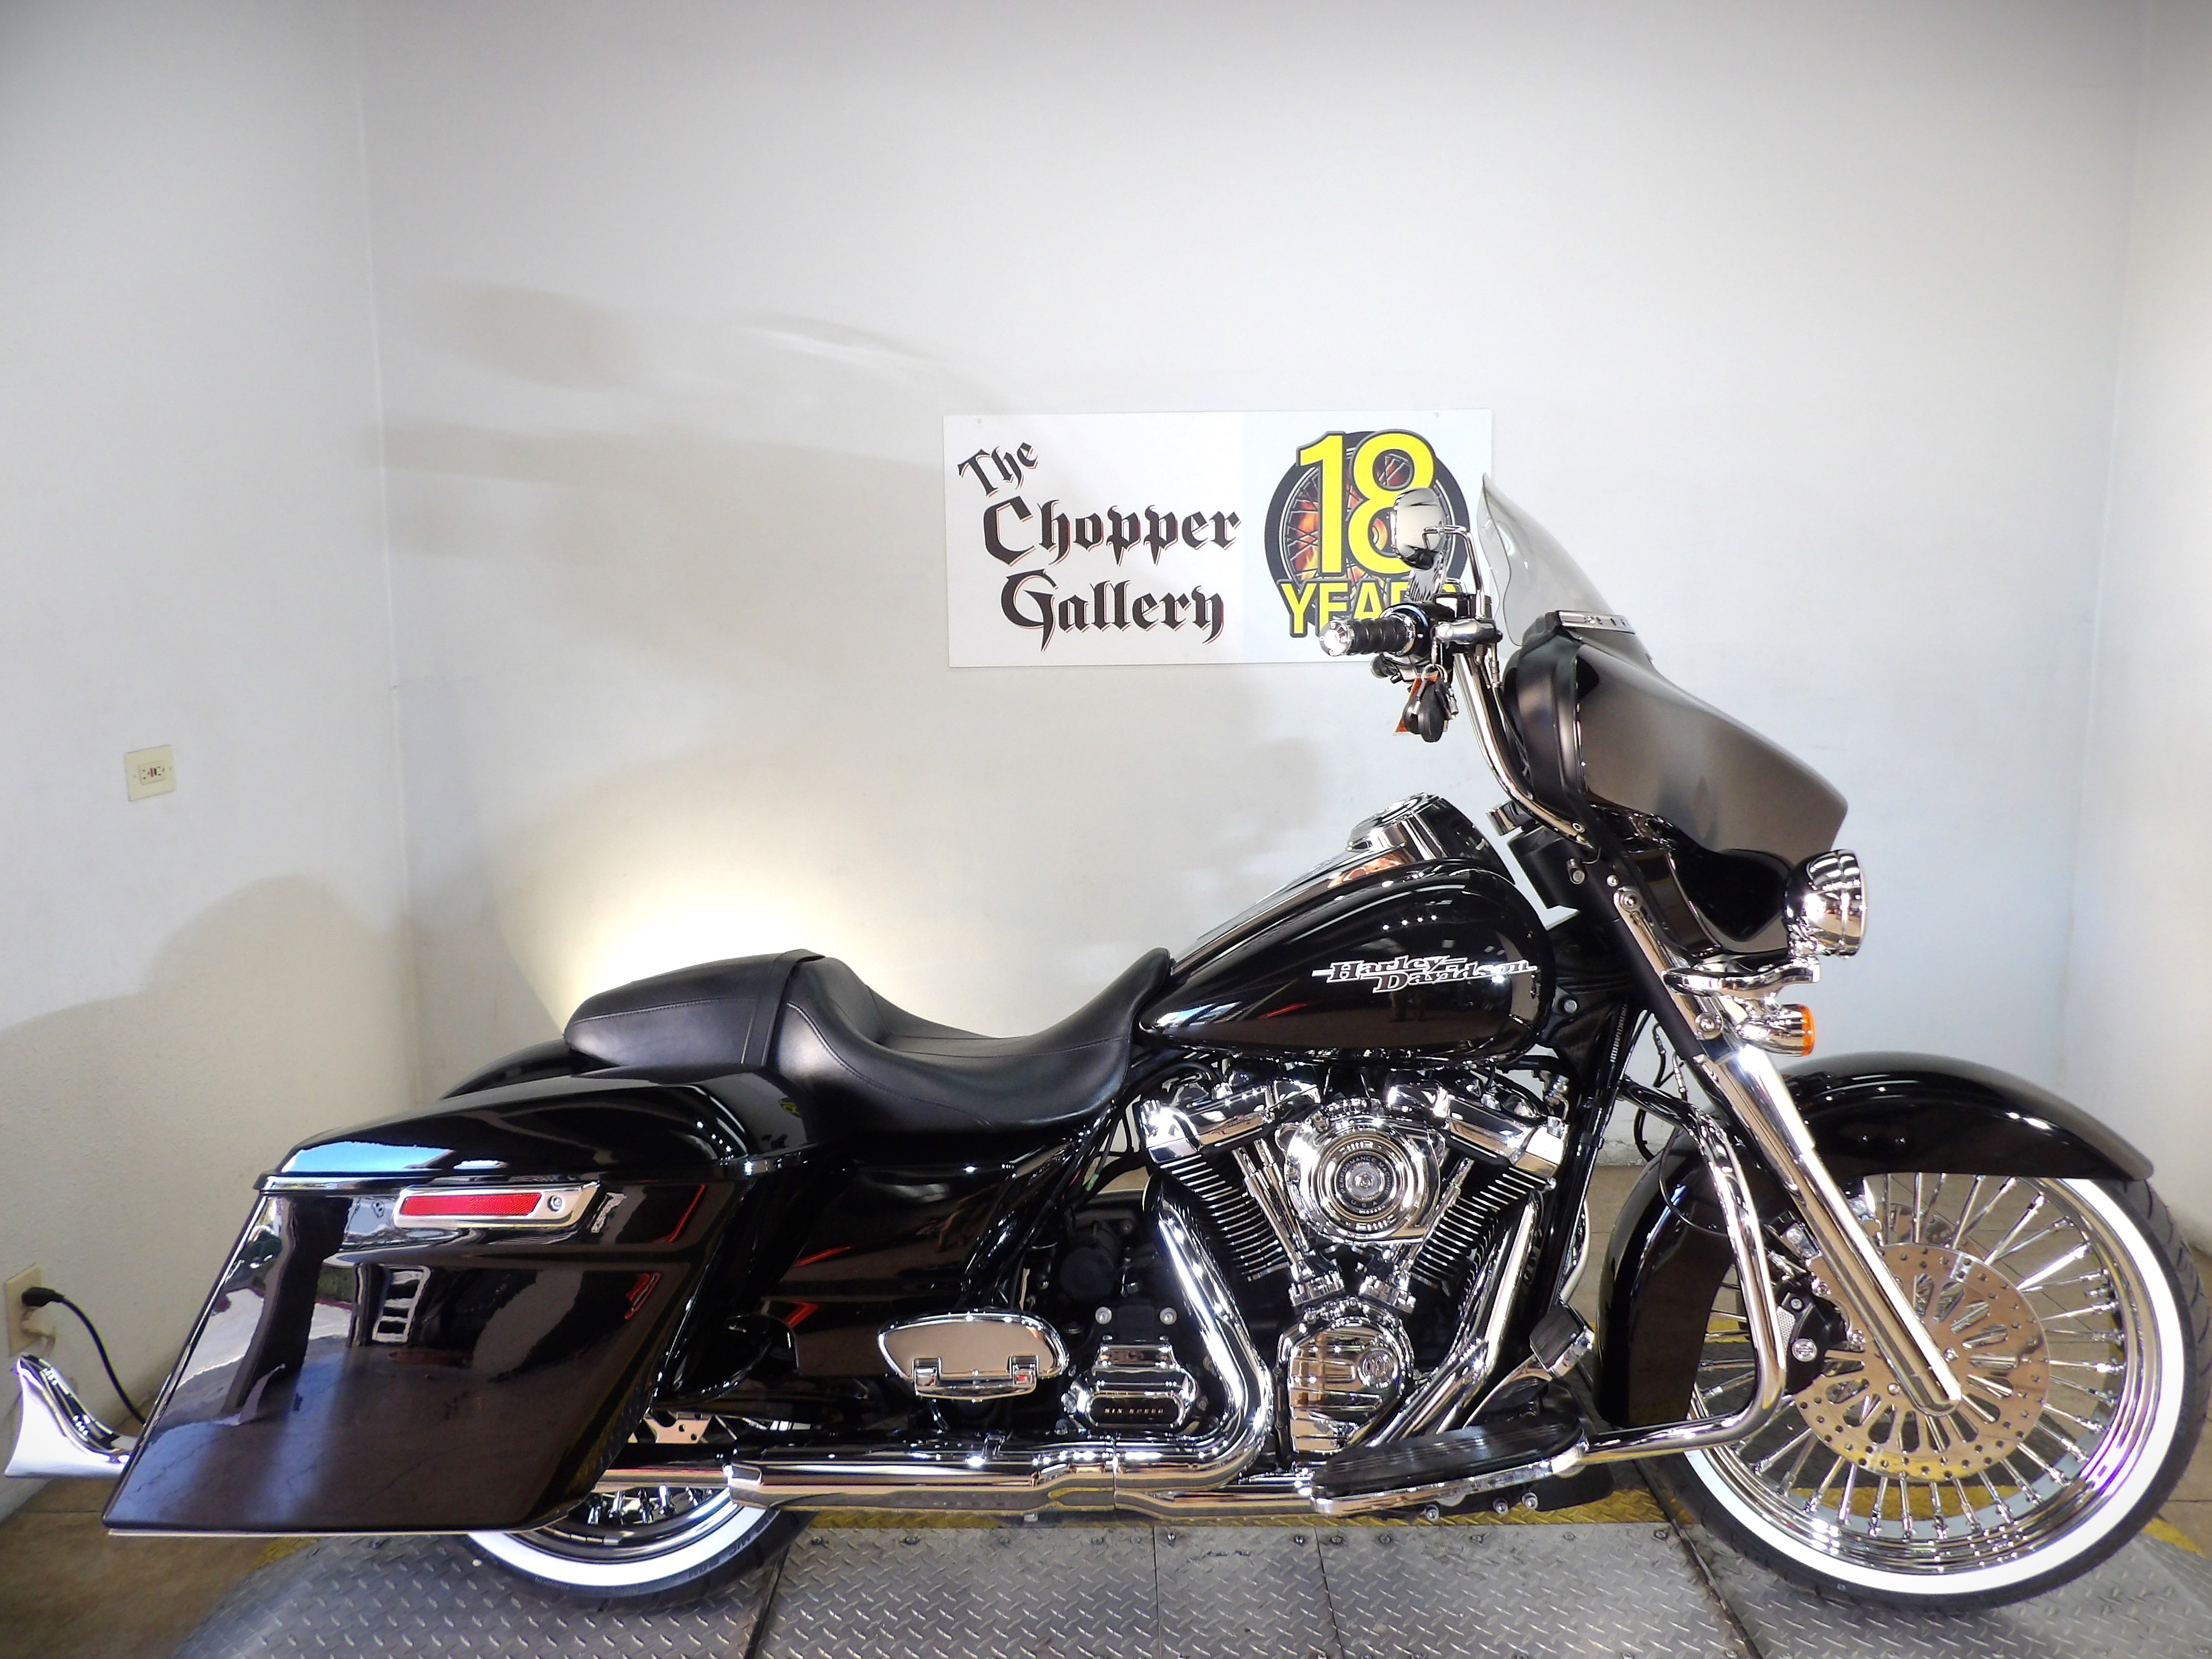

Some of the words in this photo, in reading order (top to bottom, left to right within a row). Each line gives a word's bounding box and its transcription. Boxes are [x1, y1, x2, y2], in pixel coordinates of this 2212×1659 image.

[957, 442, 1039, 497] The
[983, 495, 1241, 567] Chopper
[1298, 431, 1436, 576] 18
[1001, 568, 1224, 652] Gallery
[1280, 581, 1457, 635] YEA
[1372, 959, 1538, 994] Davidson
